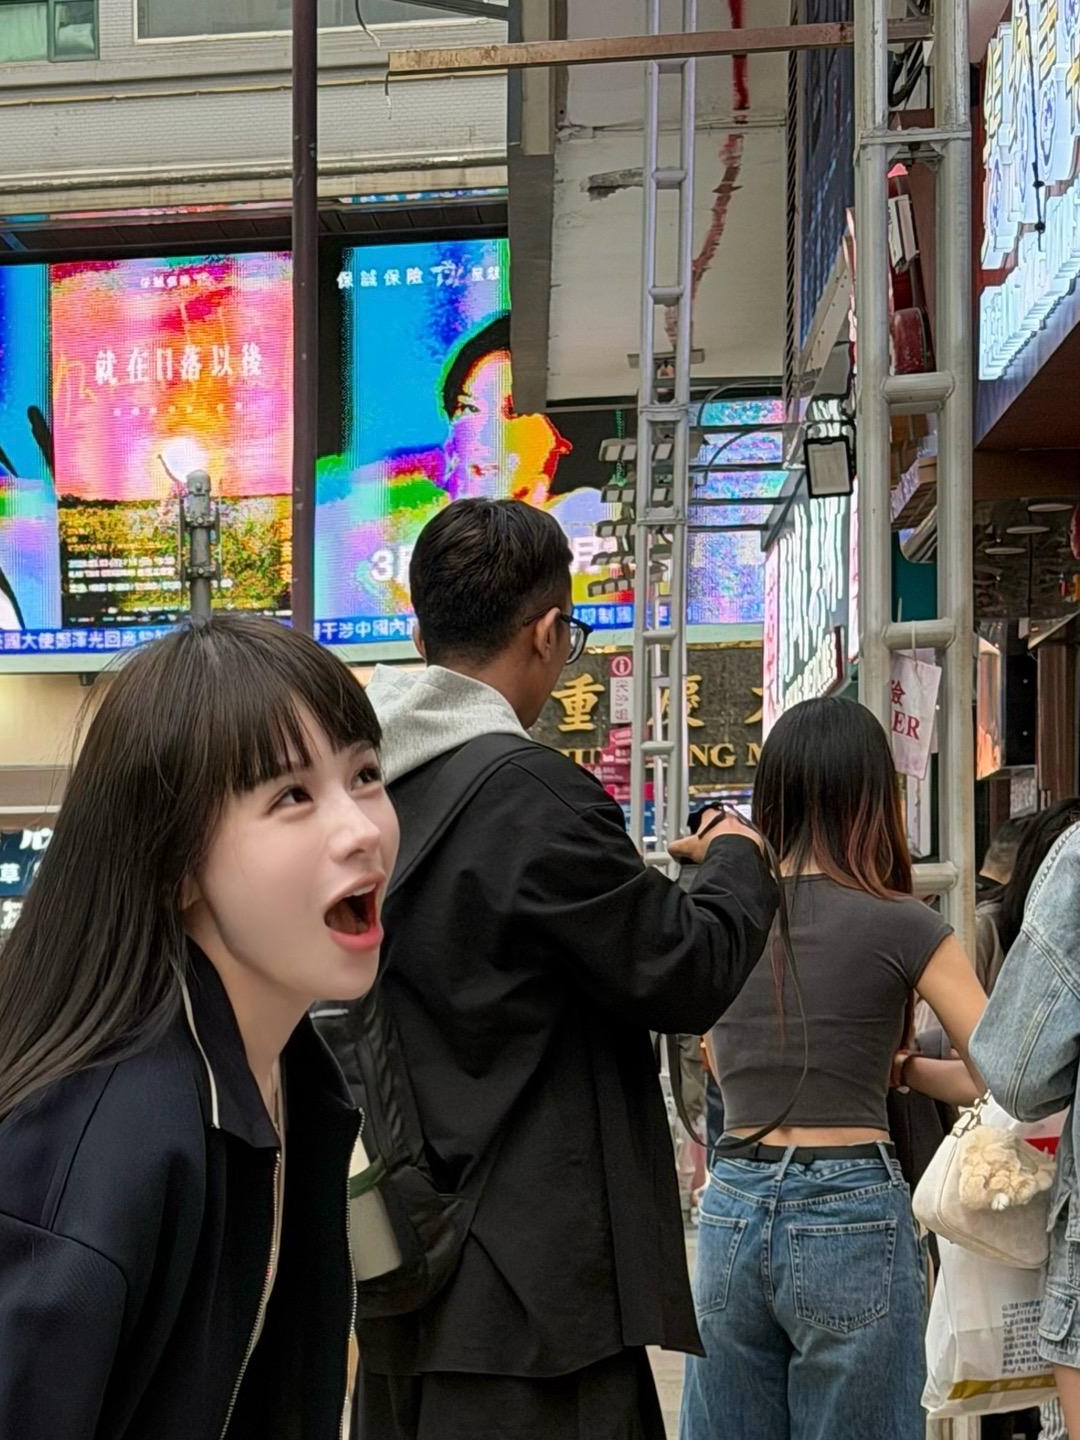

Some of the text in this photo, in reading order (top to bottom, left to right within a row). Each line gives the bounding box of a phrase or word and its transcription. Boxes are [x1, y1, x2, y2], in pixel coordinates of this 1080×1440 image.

[94, 342, 263, 386] 就在日落以後
